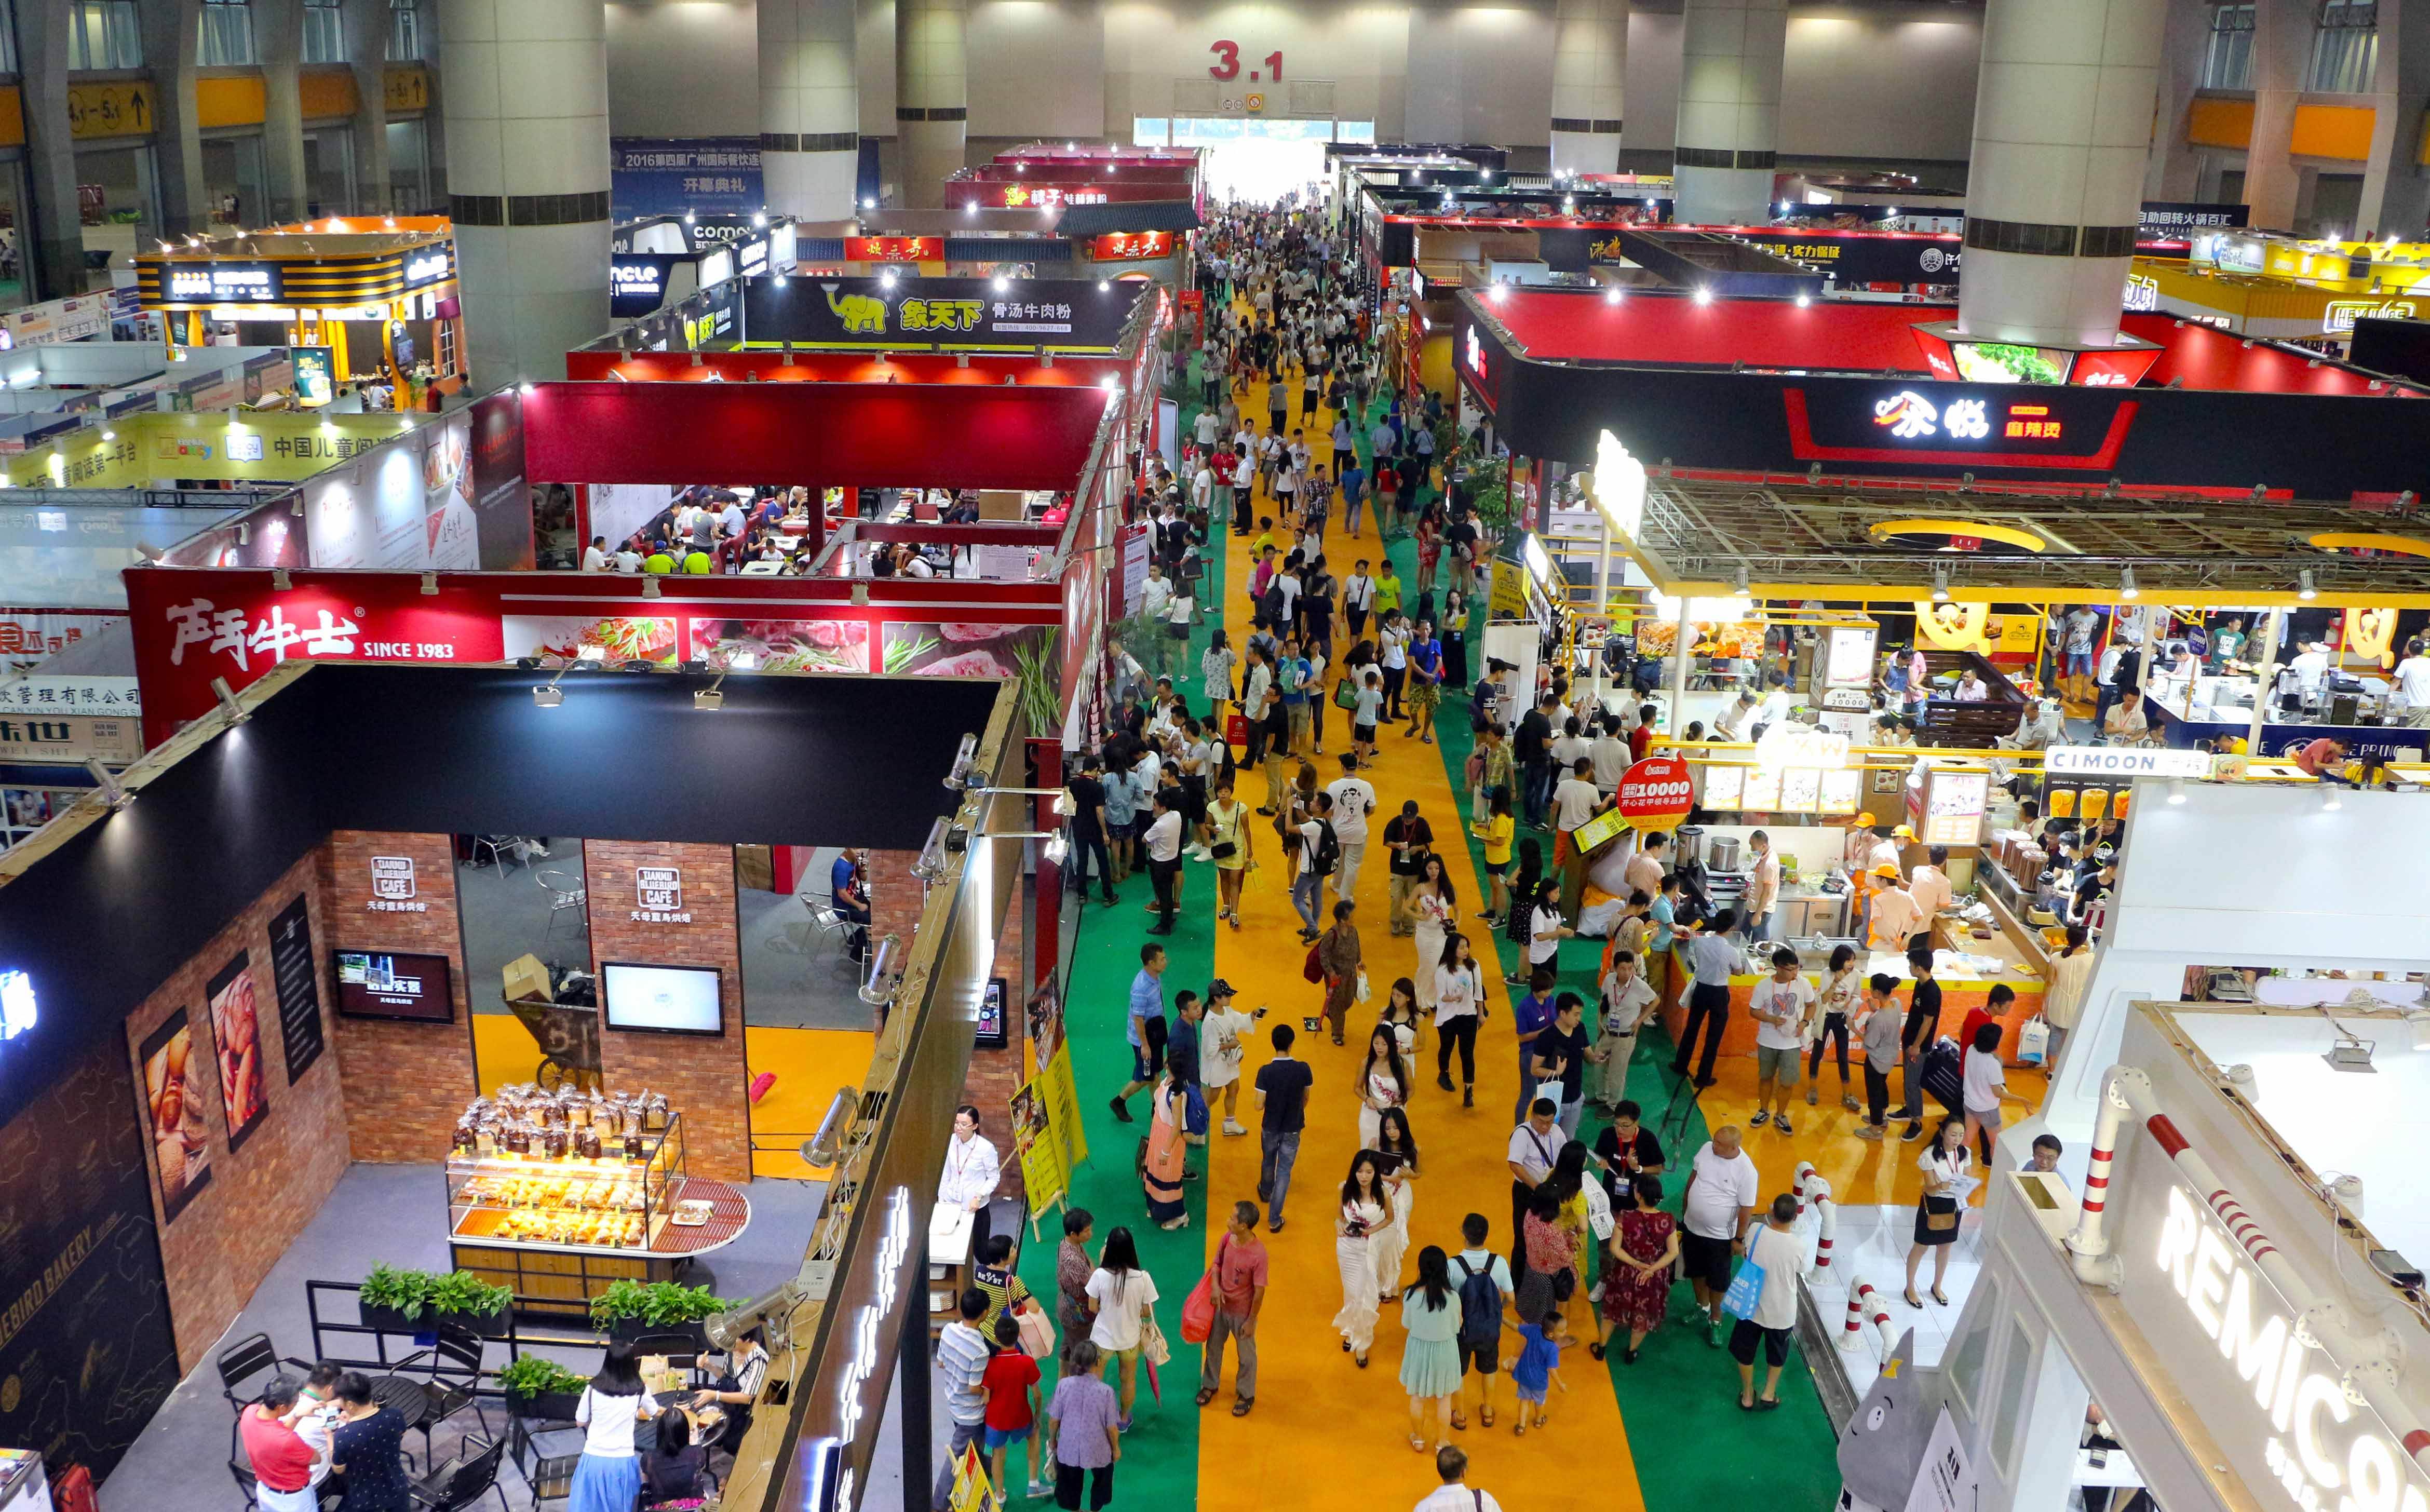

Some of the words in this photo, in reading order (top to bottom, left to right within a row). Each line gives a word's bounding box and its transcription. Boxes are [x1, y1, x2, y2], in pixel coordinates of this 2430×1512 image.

[1209, 39, 1283, 82] 3.1
[626, 154, 762, 167] 2016第四届广州国际餐饮连
[683, 177, 746, 192] 开幕典礼
[901, 299, 983, 330] 象天下
[992, 302, 1071, 319] 骨汤牛肉粉
[2006, 421, 2061, 439] 麻辣烫
[25, 442, 138, 488] 中国童阅读第一平台
[364, 642, 411, 657] SINCE
[416, 643, 454, 659] 1983
[2360, 744, 2411, 758] PRINC
[2054, 753, 2155, 770] CIMOON
[1636, 781, 1690, 798] 10000
[44, 1224, 92, 1295] BAKERY
